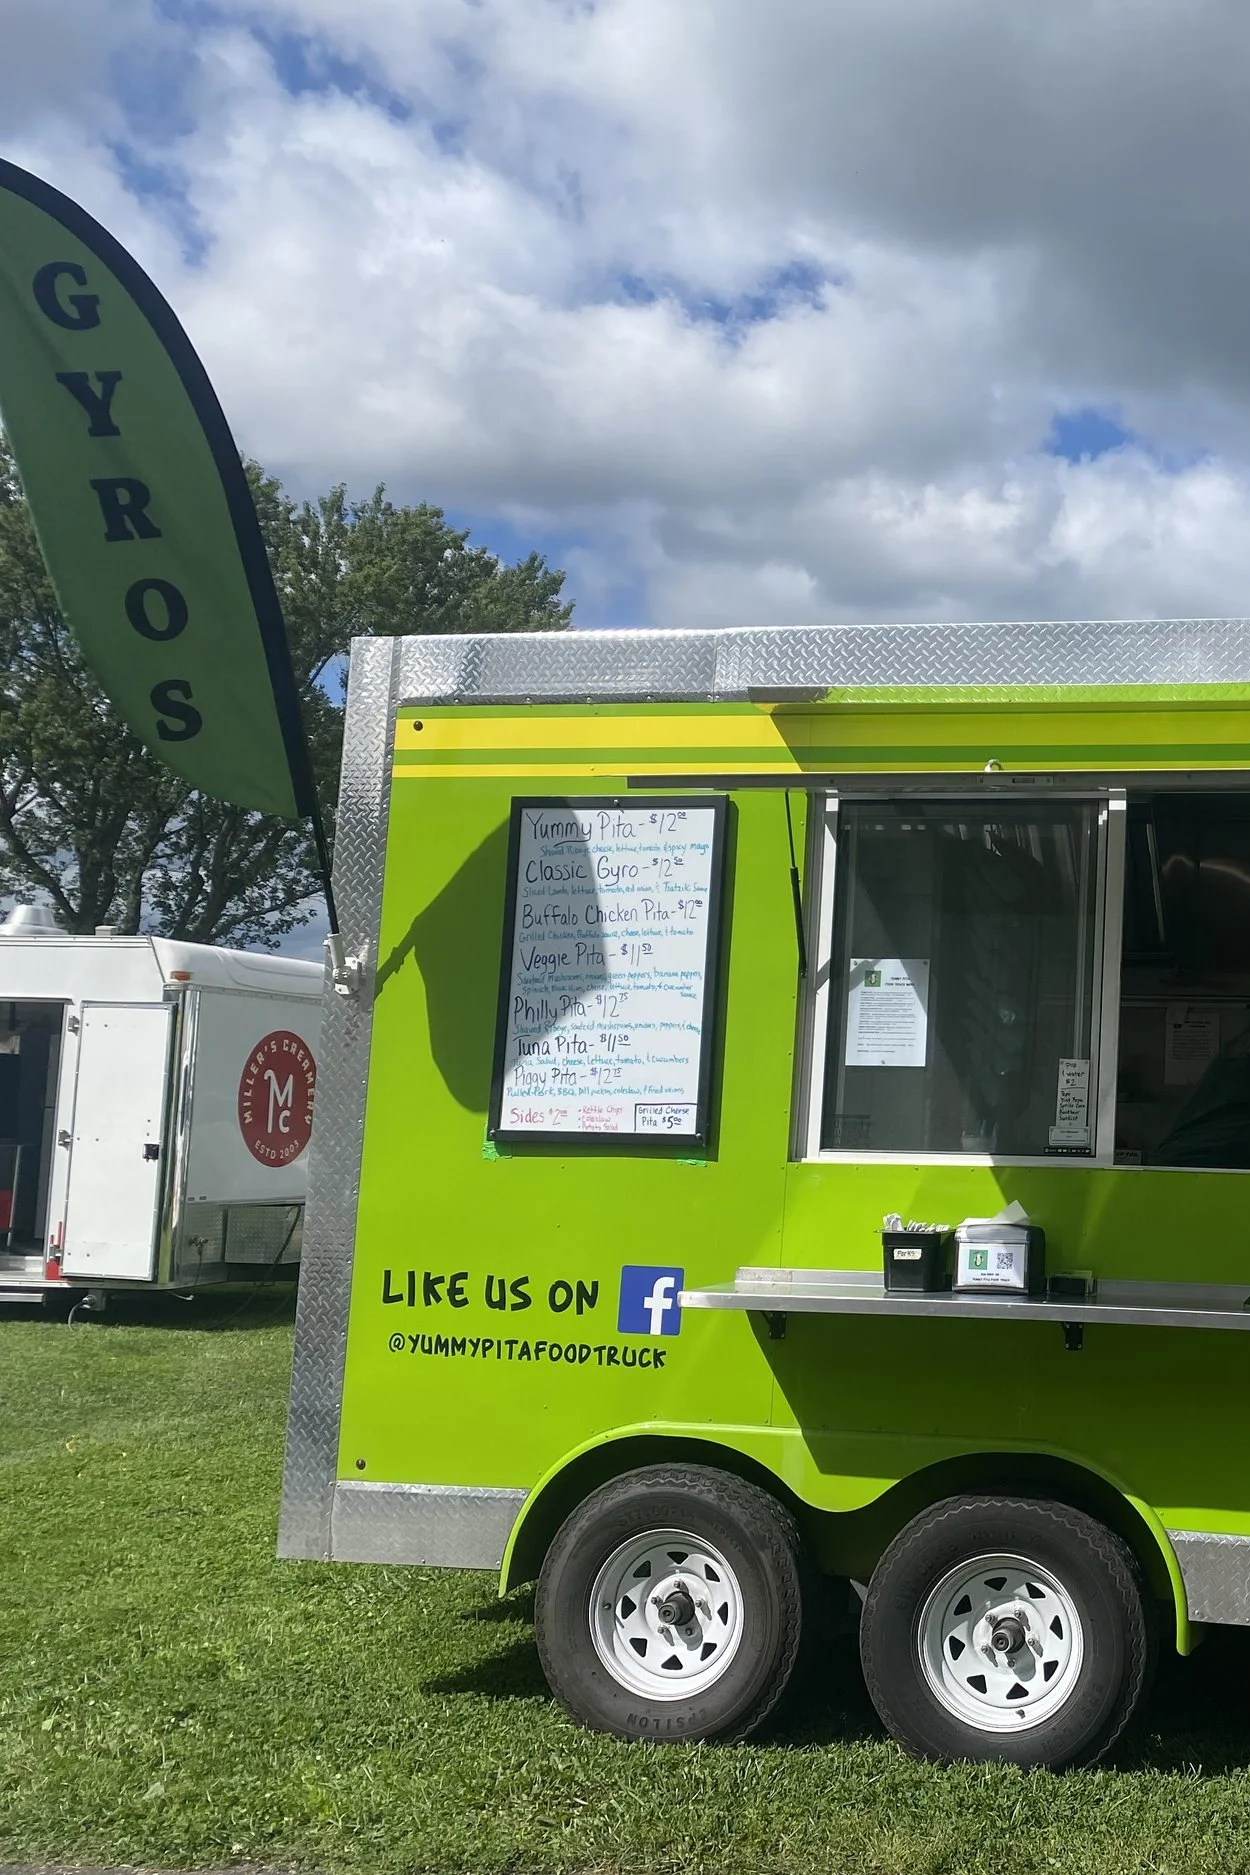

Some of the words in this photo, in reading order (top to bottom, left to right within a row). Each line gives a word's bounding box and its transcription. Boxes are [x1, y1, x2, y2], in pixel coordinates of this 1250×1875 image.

[32, 261, 203, 742] GYROS
[526, 812, 592, 848] Yummy
[597, 811, 636, 840] Pita
[526, 860, 587, 883] Classic
[597, 855, 638, 886] Gyro
[522, 904, 578, 929] Buffalo
[585, 902, 638, 924] Chicken
[520, 946, 571, 975] Veggie
[575, 942, 605, 966] Pita
[514, 995, 557, 1027] Philly
[513, 1035, 550, 1056] Tuna
[243, 1040, 277, 1124] MILLER'S
[514, 1065, 547, 1089] Piggy
[551, 1067, 577, 1086] Pita
[510, 1107, 544, 1124] Sides
[642, 1116, 657, 1127] Pita
[255, 1139, 277, 1160] ESTD
[279, 1139, 300, 1159] 2003
[381, 1269, 470, 1308] LIKE
[484, 1274, 533, 1312] US
[548, 1279, 599, 1315] ON
[388, 1332, 667, 1369] @YUMMYPITAFOODTRUCK
